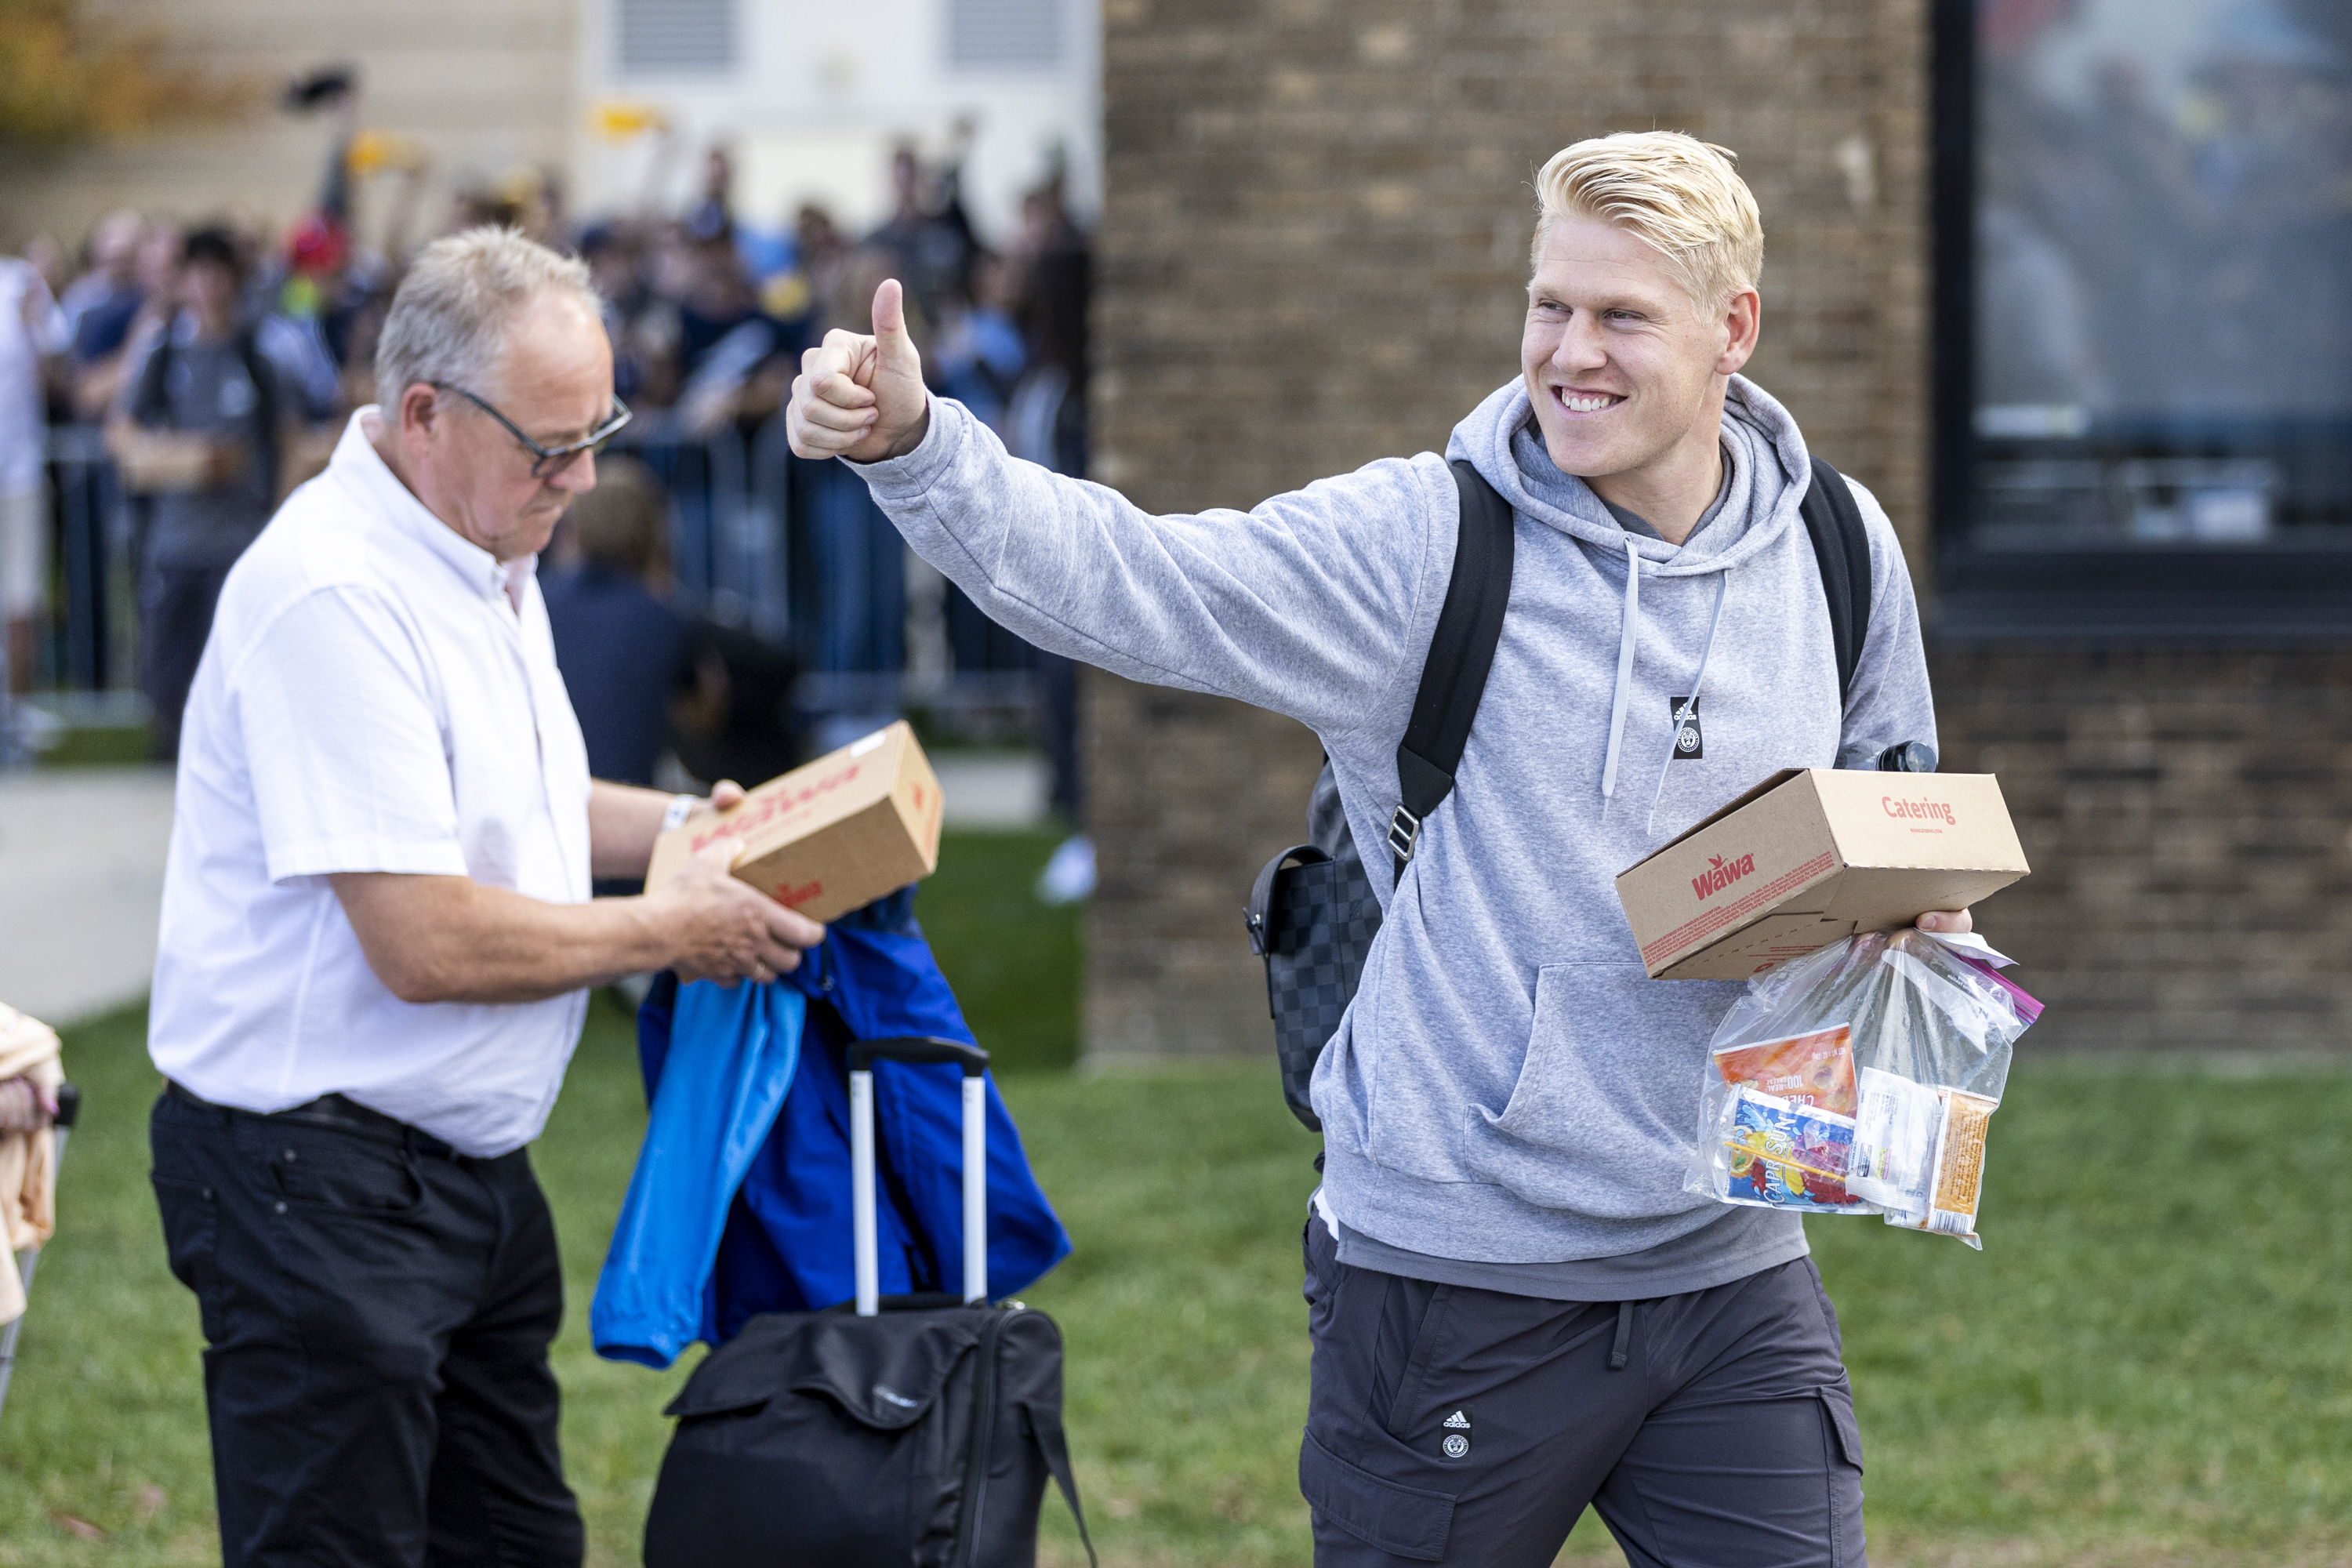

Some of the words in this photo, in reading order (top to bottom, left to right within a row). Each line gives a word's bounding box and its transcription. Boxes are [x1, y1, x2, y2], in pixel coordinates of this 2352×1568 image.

[1882, 796, 1956, 825] Catering
[1691, 854, 1755, 900] Wawa
[1766, 1077, 1786, 1085] CHEESE
[1765, 1113, 1796, 1156] SUN
